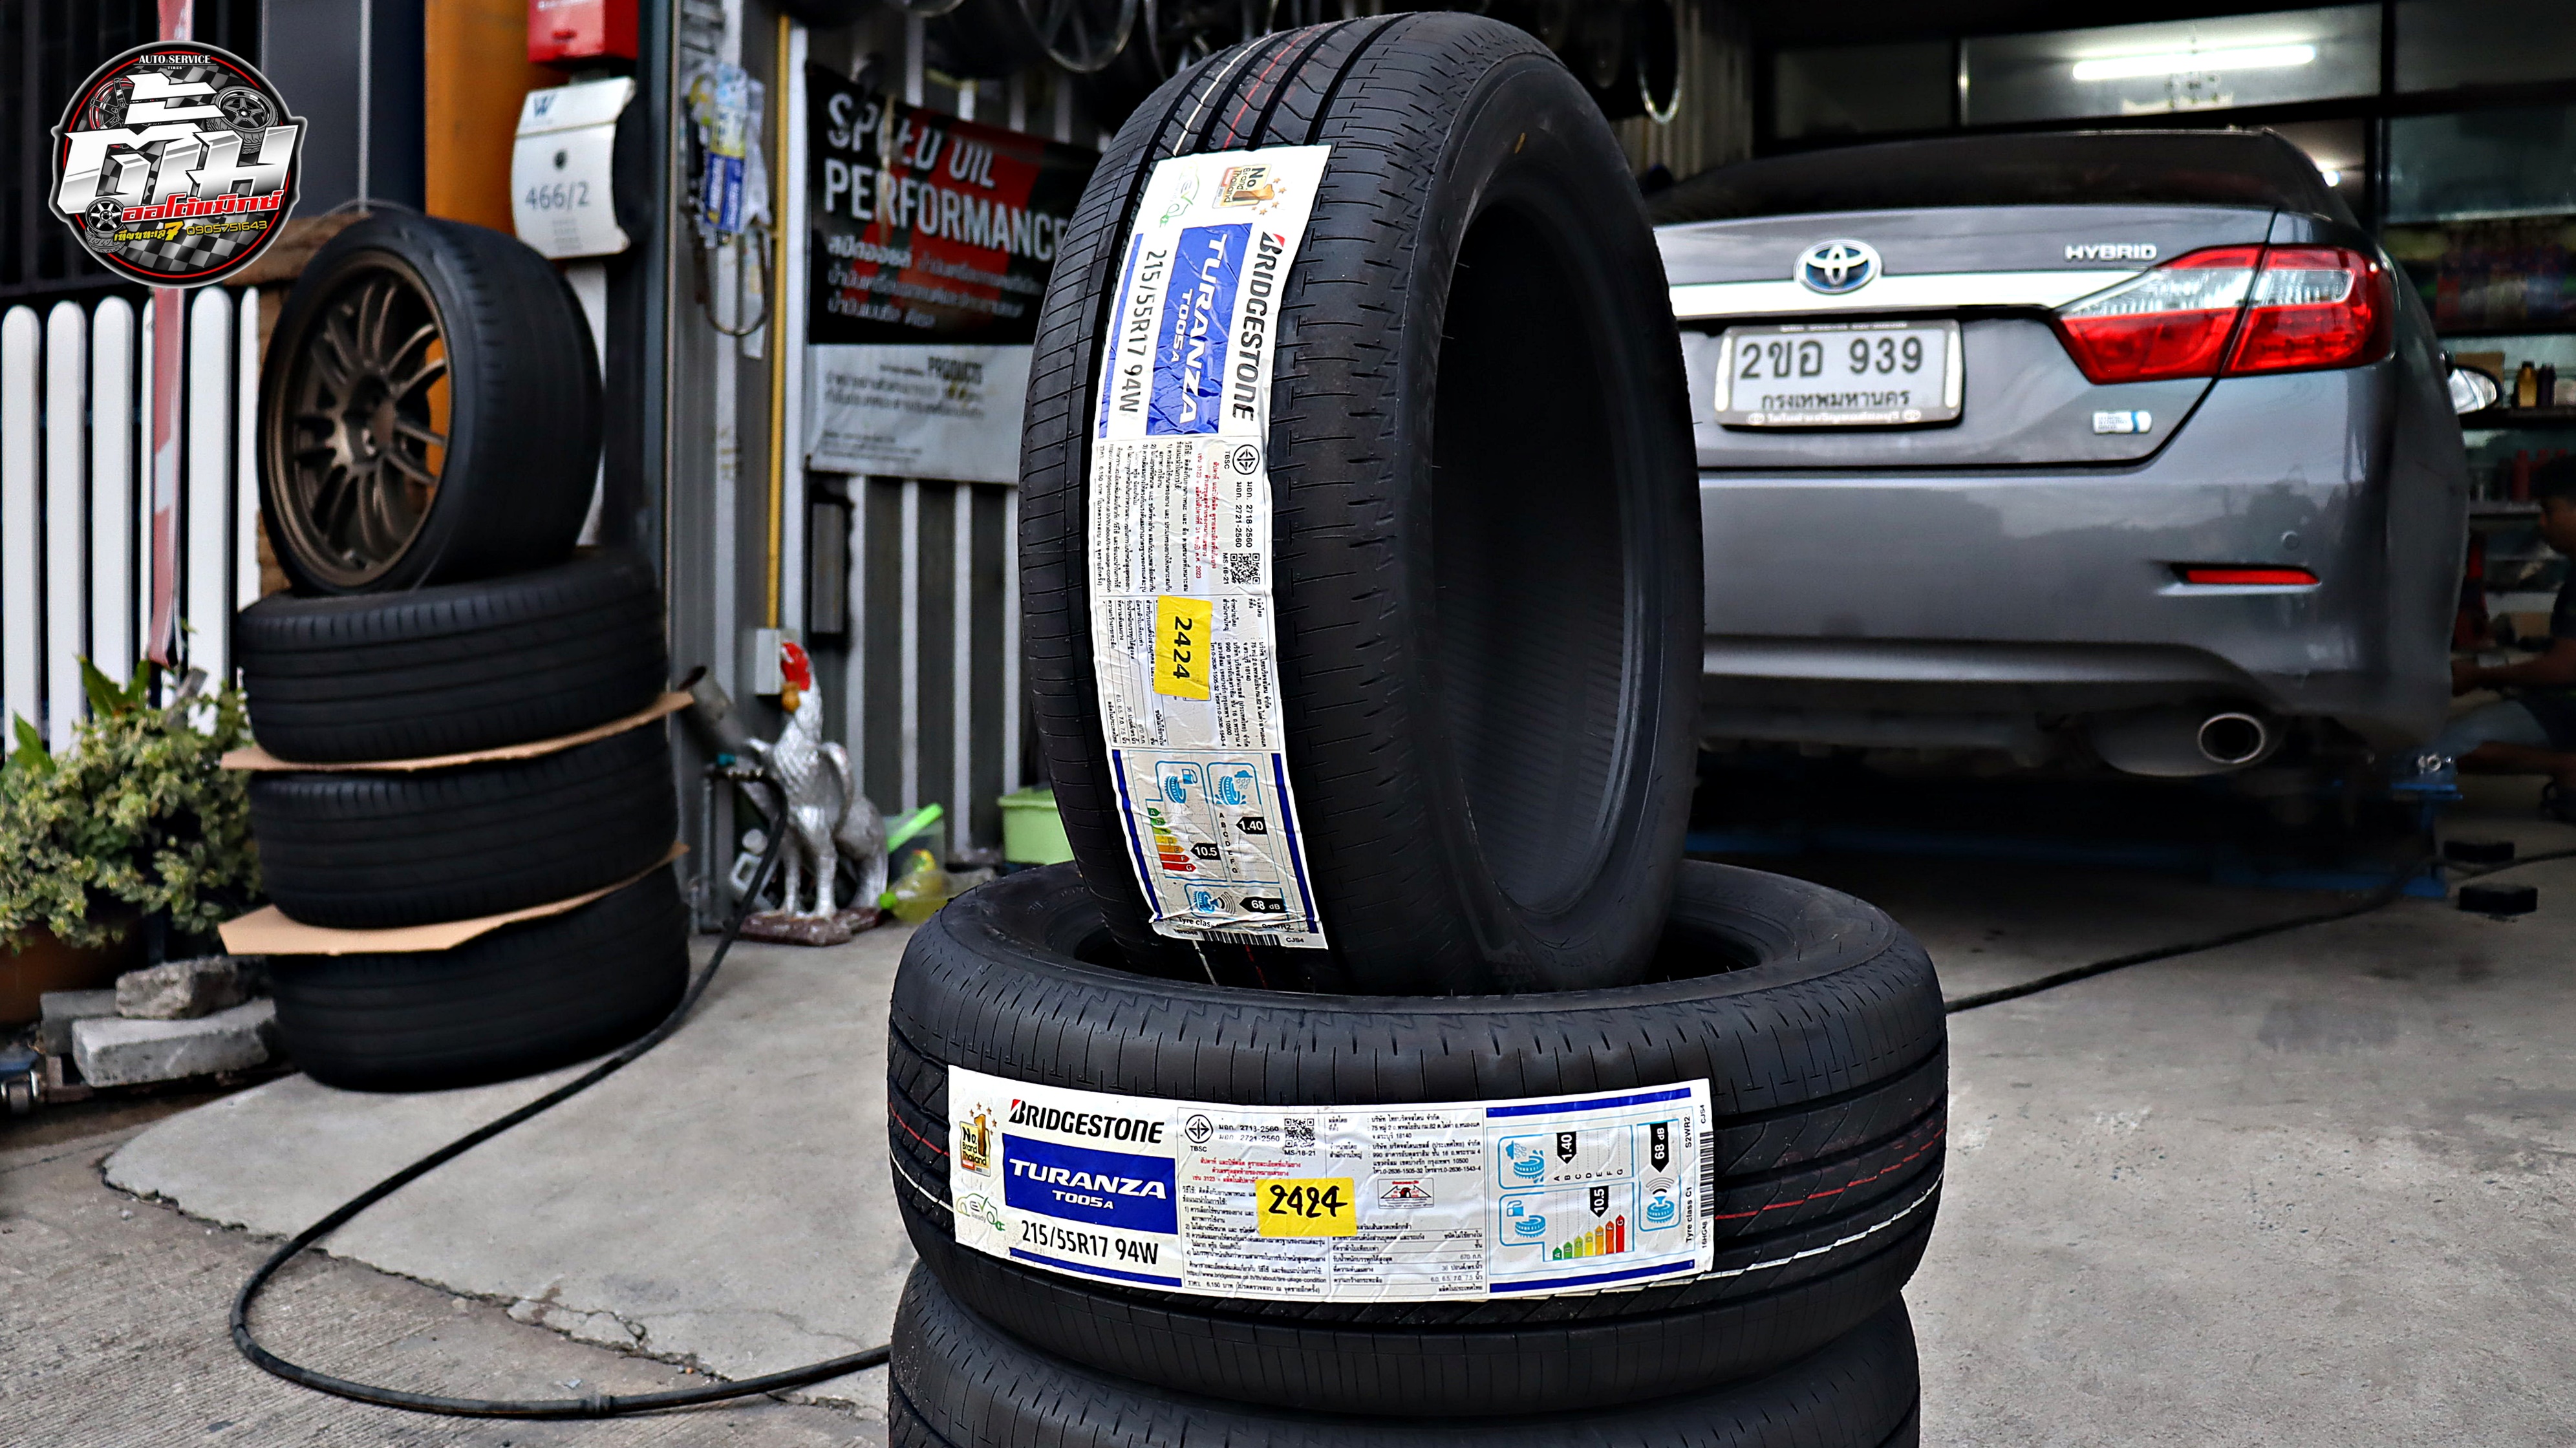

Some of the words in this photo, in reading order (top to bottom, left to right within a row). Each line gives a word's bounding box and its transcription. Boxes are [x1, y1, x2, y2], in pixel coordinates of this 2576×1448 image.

[1223, 170, 1243, 203] Thailand
[1237, 168, 1252, 190] Brand
[525, 181, 588, 210] 466/2
[2065, 244, 2157, 262] HYBRID
[1128, 250, 1166, 356] 215/55R17
[1180, 233, 1227, 423] TURANZA
[1233, 232, 1285, 421] BRIDGESTONE
[1740, 341, 1824, 379] 2ขอ
[1849, 336, 1923, 374] 939
[1119, 364, 1143, 412] 94W
[1173, 616, 1192, 679] 2424
[1240, 820, 1263, 831] 1.40
[1195, 847, 1218, 857] 10.5
[1250, 900, 1265, 910] 68
[962, 1126, 977, 1144] No.
[1009, 1099, 1165, 1144] BRIDGESTONE
[1657, 1127, 1665, 1140] dB
[1684, 1116, 1692, 1148] S2WR2
[962, 1142, 978, 1154] Brand
[963, 1150, 987, 1166] Thailand
[1561, 1134, 1572, 1160] 1.40
[1655, 1144, 1665, 1160] 68
[1009, 1158, 1166, 1199] TURANZA
[1686, 1187, 1692, 1197] C1
[1268, 1184, 1347, 1218] 2424
[1594, 1189, 1604, 1213] 10.5
[1022, 1220, 1108, 1257] 215/55R17
[1115, 1239, 1159, 1265] 94W
